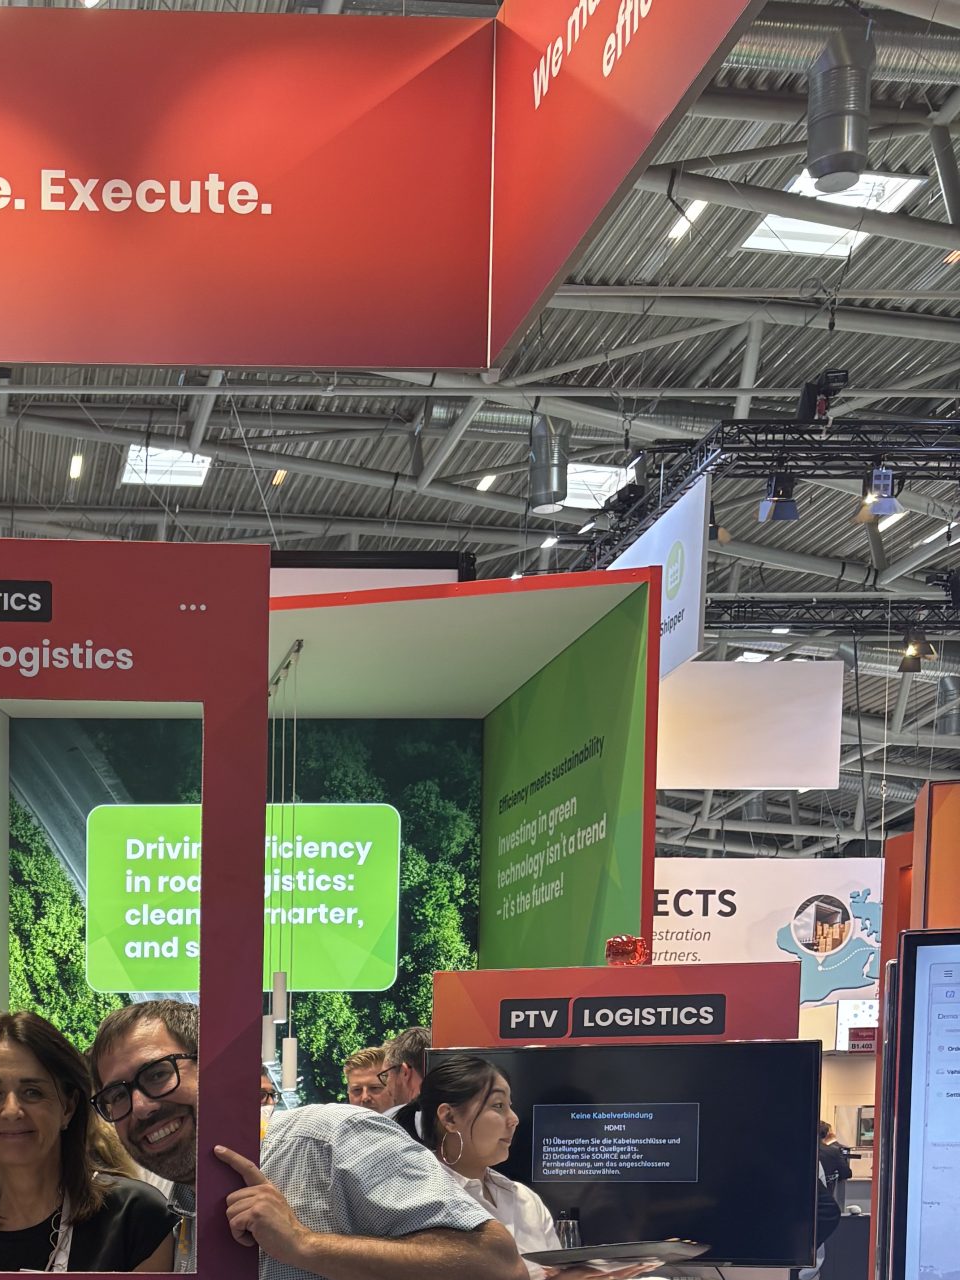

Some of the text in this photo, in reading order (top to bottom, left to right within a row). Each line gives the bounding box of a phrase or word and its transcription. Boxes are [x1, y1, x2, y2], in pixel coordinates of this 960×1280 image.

[533, 36, 563, 110] We
[41, 168, 272, 215] Execute.
[660, 608, 685, 637] Shipper
[498, 735, 605, 815] Efficiency meets sustainability
[498, 796, 577, 857] Investing in green
[497, 848, 545, 889] technology
[568, 835, 576, 854] a
[576, 812, 607, 849] trend
[126, 869, 151, 893] in
[157, 874, 201, 893] roa
[516, 890, 531, 914] the
[531, 871, 564, 908] future!
[125, 903, 364, 928] clean marter,
[653, 889, 737, 918] ECTS
[125, 936, 179, 959] and
[510, 1006, 714, 1028] PTV LOGISTICS
[570, 1112, 653, 1120] Keine Kabelverbindung
[542, 1145, 585, 1153] Einstellungen
[552, 1137, 589, 1146] Überprüfen
[602, 1137, 612, 1145] die
[613, 1137, 667, 1145] Kabelanschlüsse
